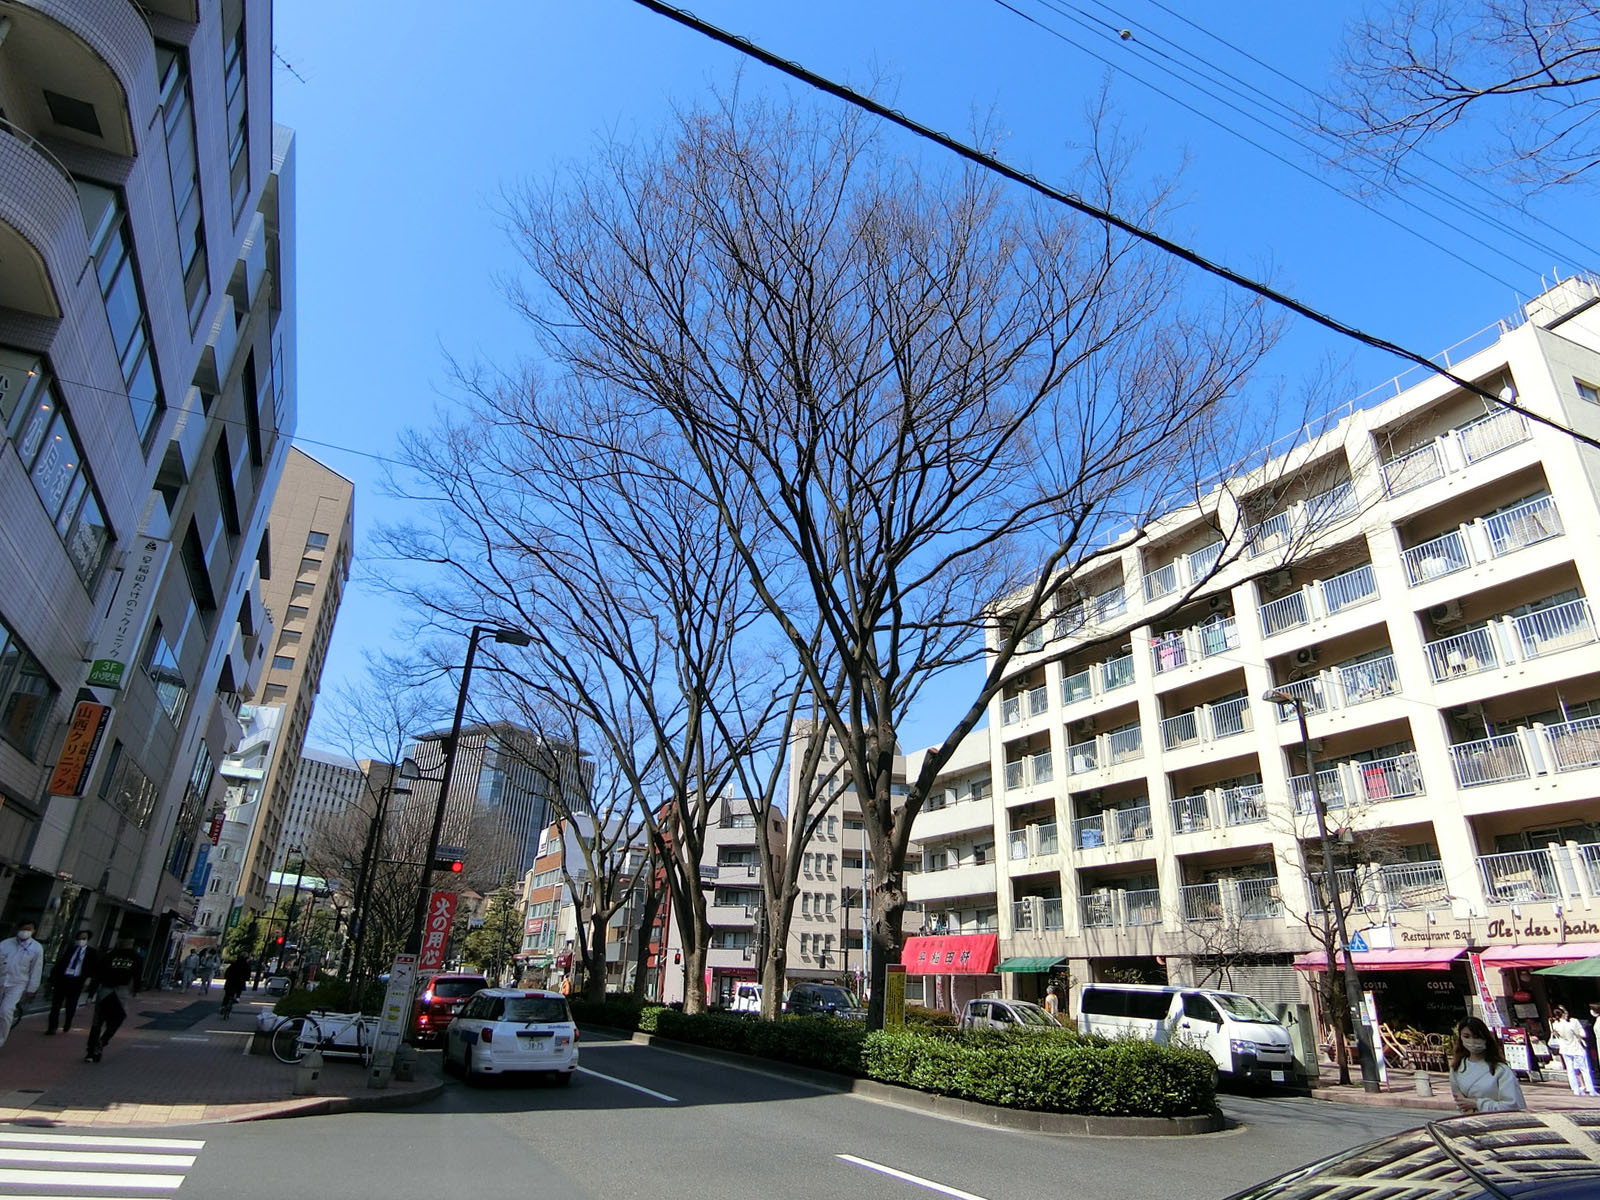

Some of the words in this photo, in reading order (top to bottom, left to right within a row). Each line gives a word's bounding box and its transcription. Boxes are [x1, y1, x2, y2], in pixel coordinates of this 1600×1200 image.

[102, 661, 118, 672] 3F
[91, 670, 121, 683] 小児科
[53, 706, 93, 790] 山西クリニック
[421, 897, 451, 966] 火の用心
[1524, 918, 1551, 937] des
[1401, 931, 1450, 942] Restaurant
[1453, 929, 1472, 940] Bar
[1363, 981, 1388, 990] COSTA
[1427, 981, 1455, 990] COSTA
